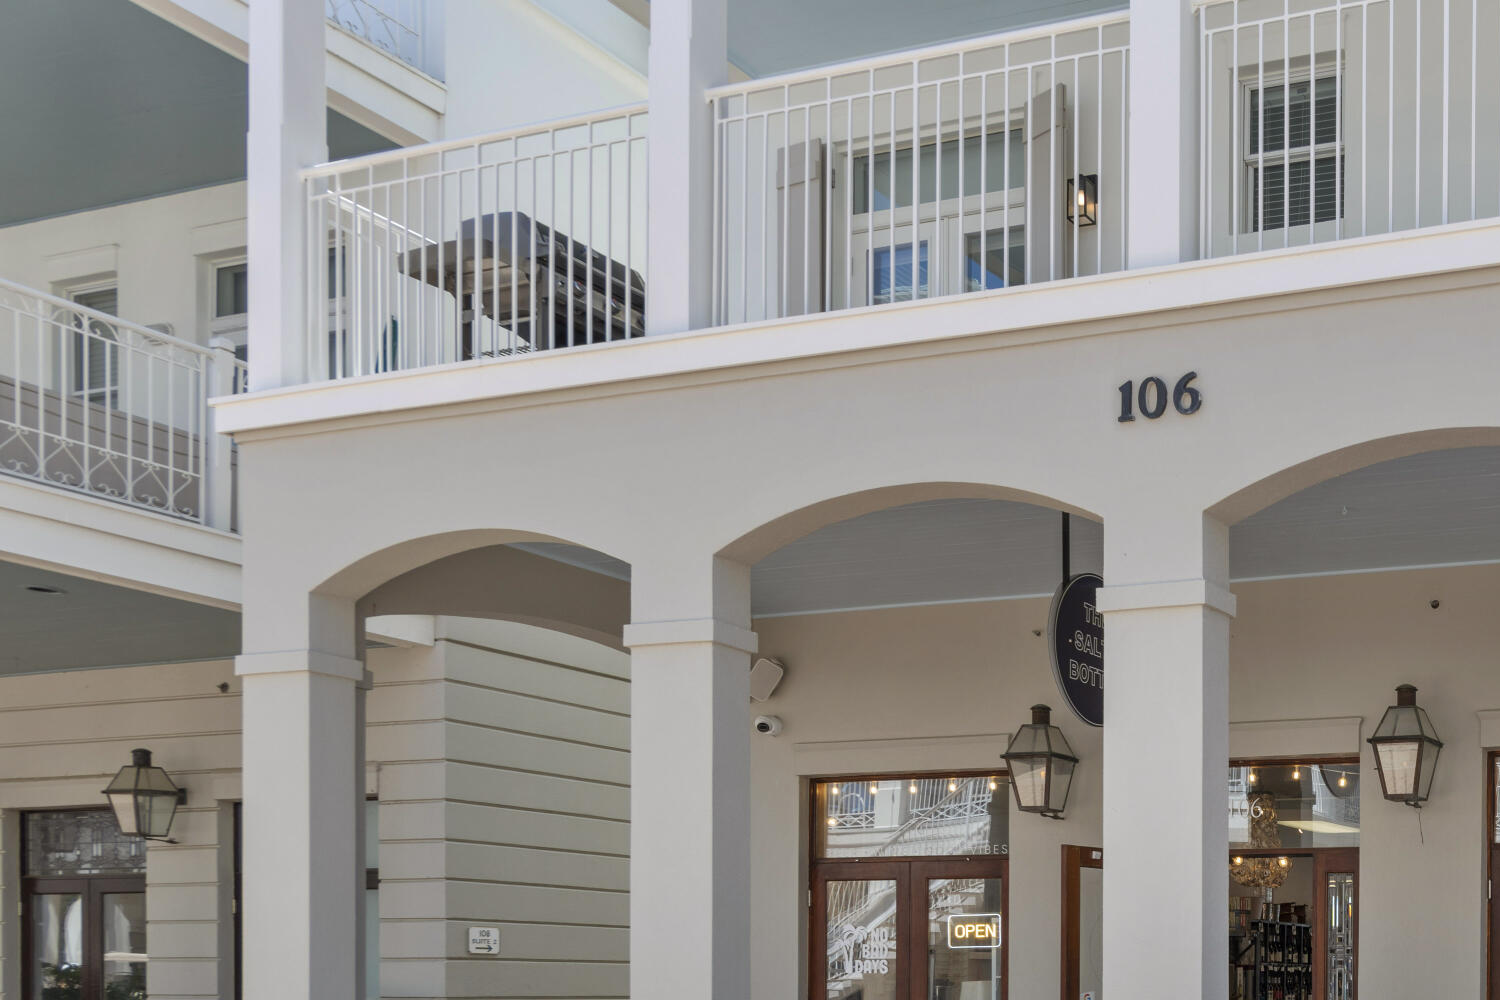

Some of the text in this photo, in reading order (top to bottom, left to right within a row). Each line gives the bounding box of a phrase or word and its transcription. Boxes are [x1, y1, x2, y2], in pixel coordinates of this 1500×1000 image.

[1117, 371, 1203, 423] 106
[1083, 602, 1104, 628] TH
[1074, 630, 1104, 658] SAL
[970, 844, 1009, 856] VIBES
[871, 927, 889, 943] NO
[954, 923, 997, 939] OPEN
[862, 943, 889, 959] BAD
[854, 959, 889, 975] DAYS
